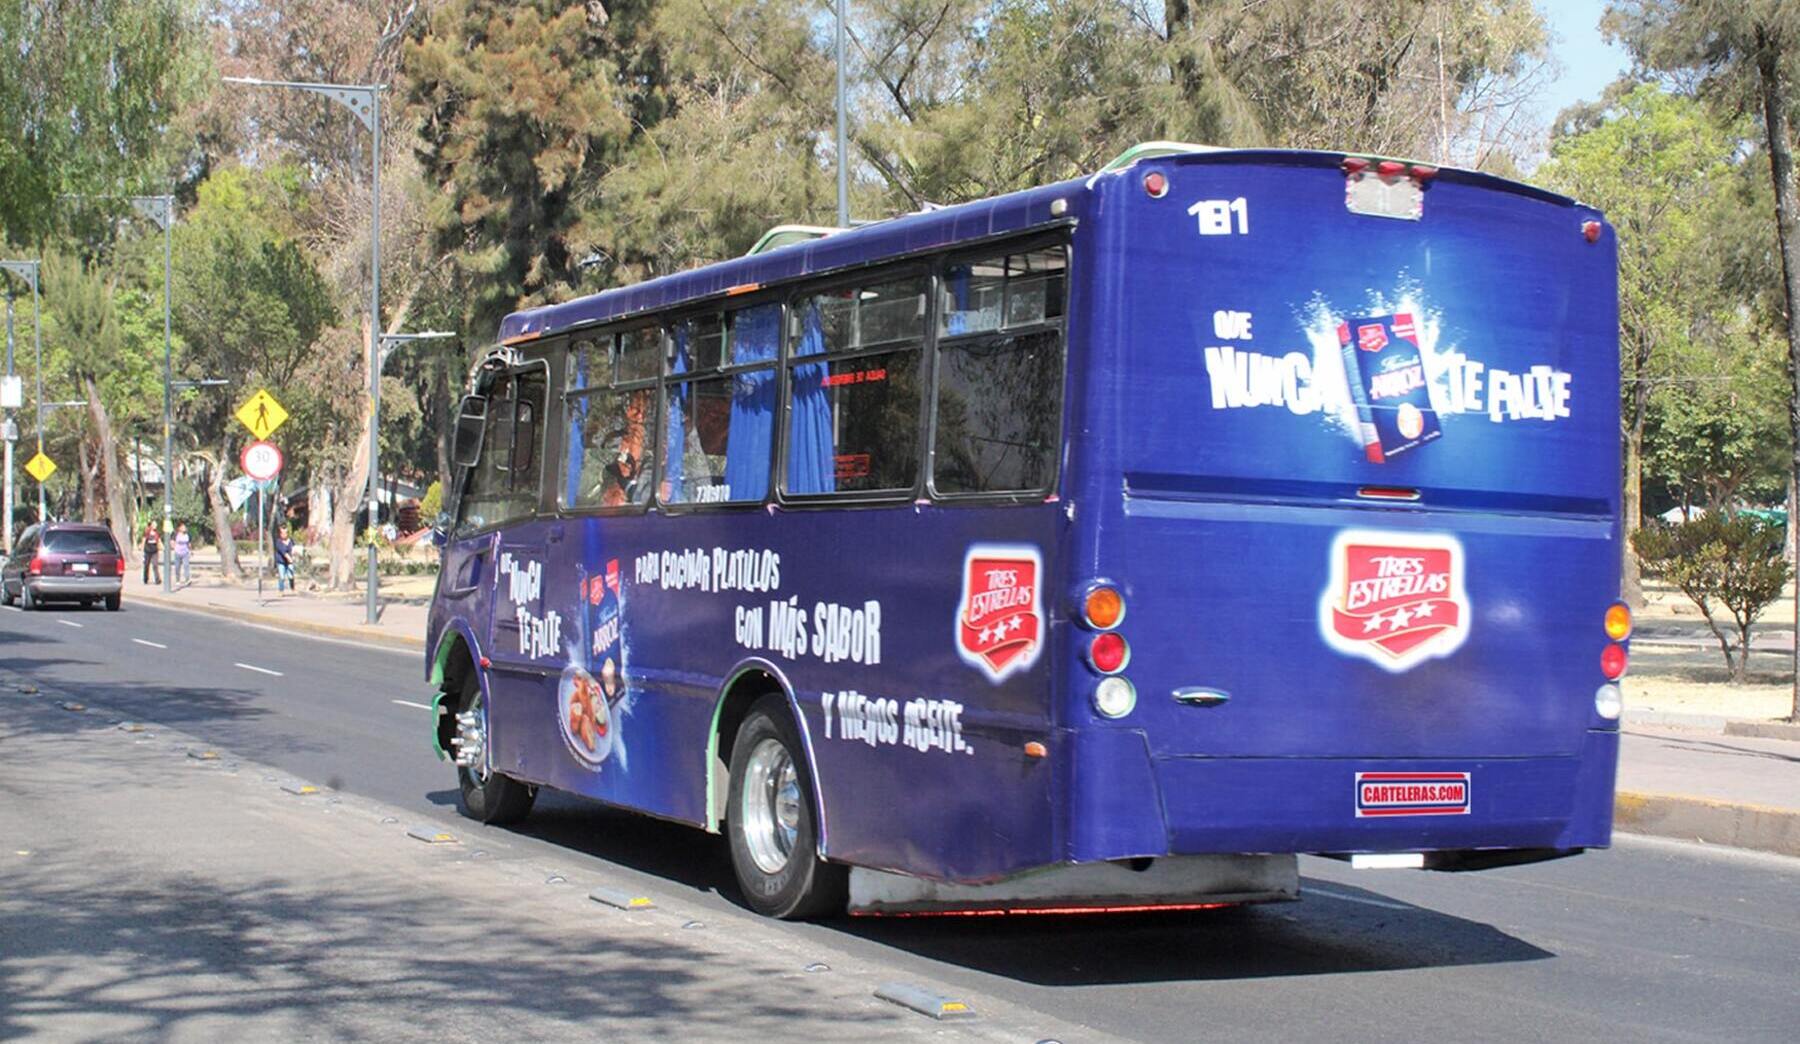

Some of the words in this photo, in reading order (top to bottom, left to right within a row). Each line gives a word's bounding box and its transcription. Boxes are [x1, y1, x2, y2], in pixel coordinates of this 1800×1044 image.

[1187, 197, 1248, 235] 181
[1213, 310, 1253, 340] QUE
[1440, 352, 1484, 414] TE
[1489, 365, 1572, 423] FALTE
[255, 450, 270, 464] 30
[510, 560, 541, 606] NUNCA
[635, 551, 660, 585] PARA
[661, 548, 711, 592] COCINAR
[712, 547, 780, 594] PLATILLOS
[984, 568, 1019, 590] TRES
[1369, 555, 1426, 577] TRES
[969, 585, 1035, 623] ESTRELLAS
[1346, 572, 1450, 610] ESTRELLAS
[517, 606, 531, 655] TE
[531, 610, 562, 660] FALTE
[735, 605, 763, 650] CON
[768, 594, 808, 661] MÁS
[812, 600, 881, 665] SABOR
[822, 692, 835, 740] Y
[838, 690, 899, 749] MENOS
[903, 697, 975, 756] ACEITE.
[1363, 785, 1464, 803] CARTELERAS.COM
